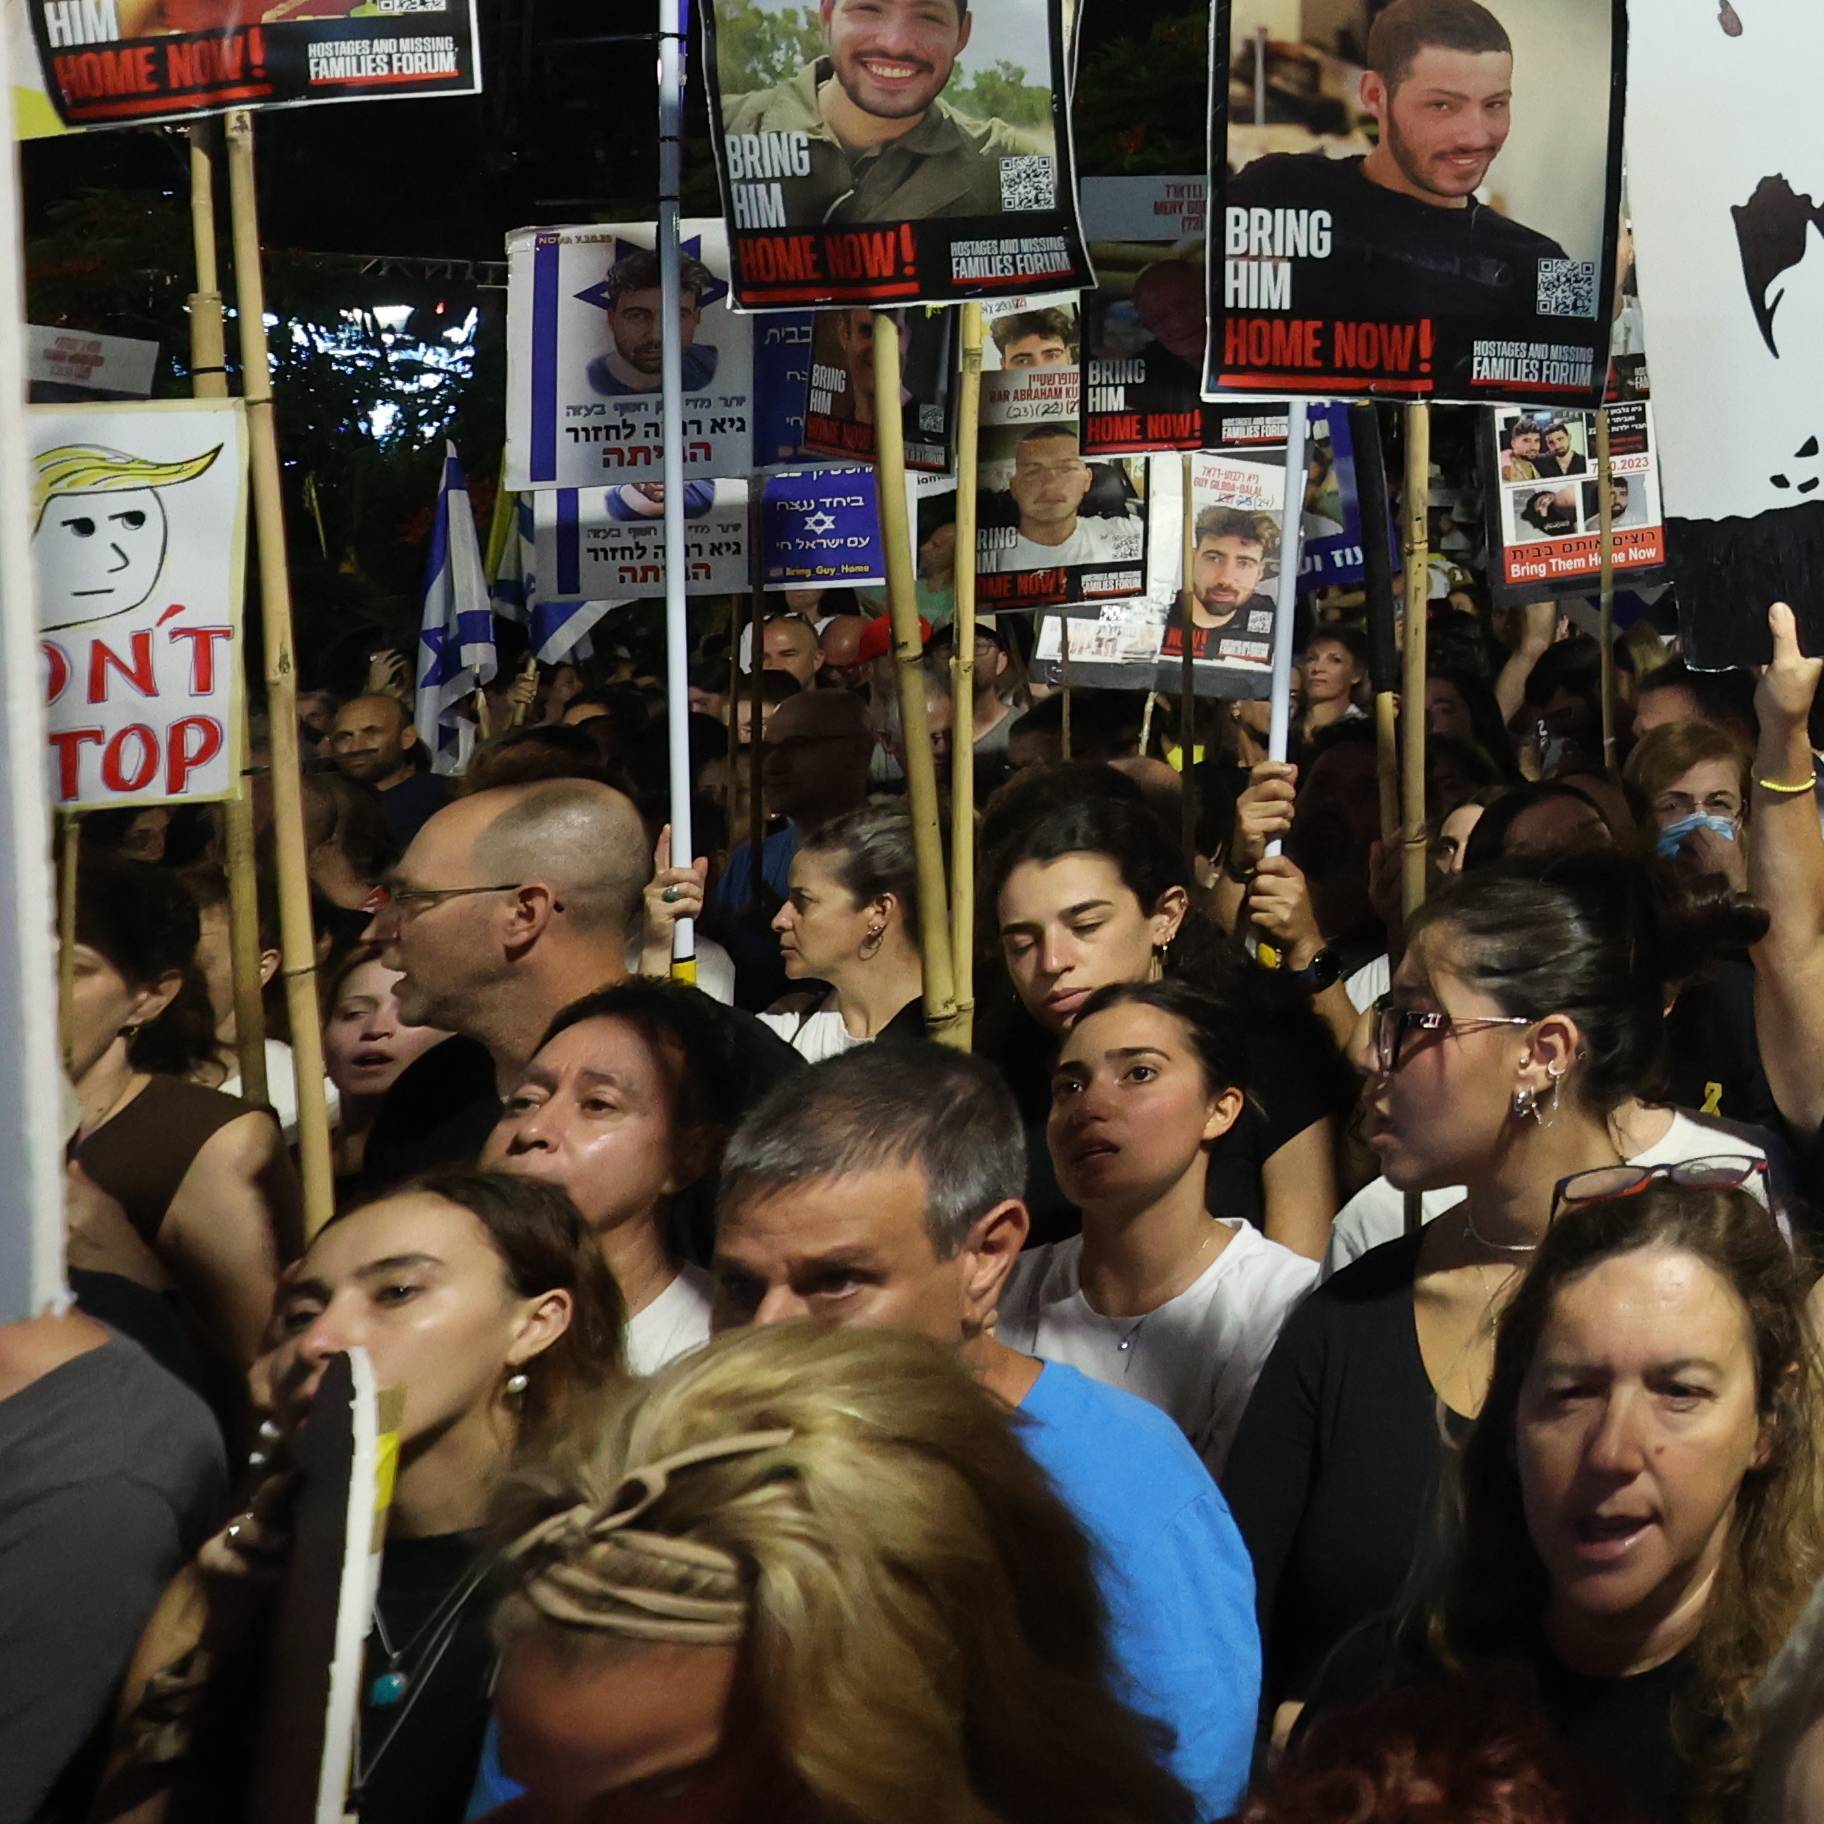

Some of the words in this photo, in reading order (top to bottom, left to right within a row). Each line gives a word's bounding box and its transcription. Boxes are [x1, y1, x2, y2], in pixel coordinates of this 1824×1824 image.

[308, 41, 370, 59] HOSTAGES
[372, 39, 398, 54] AND
[399, 36, 456, 53] MISSING
[53, 48, 158, 97] HOME
[168, 27, 266, 88] NOW!
[309, 53, 389, 80] FAMILIES
[392, 50, 457, 75] FORUM
[726, 132, 810, 179] BRING
[732, 183, 787, 229] HIM
[951, 240, 998, 256] HOSTAGES
[1000, 239, 1018, 254] AND
[1020, 236, 1065, 252] MISSING
[1225, 207, 1333, 259] BRING
[737, 237, 817, 283] HOME
[825, 223, 917, 278] NOW!
[952, 254, 1014, 279] FAMILIES
[1016, 252, 1071, 275] FORUM
[1225, 259, 1292, 311] HIM
[1224, 319, 1323, 367] HOME
[1334, 319, 1436, 374] NOW!
[1473, 340, 1526, 358] HOSTAGES
[1528, 343, 1548, 359] AND
[1550, 344, 1594, 362] MISSING
[812, 364, 846, 393] BRING
[1088, 359, 1146, 385] BRING
[1473, 357, 1539, 382] FAMILIES
[1542, 360, 1592, 386] FORUM
[810, 389, 832, 415] HIM
[1012, 387, 1063, 401] ABRAHAM
[1088, 387, 1126, 412] HIM
[566, 419, 636, 443] לחזור
[710, 417, 746, 434] גיא
[1087, 415, 1142, 442] HOME
[1147, 409, 1202, 439] NOW!
[1222, 426, 1260, 439] FAMILIES
[602, 442, 712, 468] היתה
[820, 496, 864, 508] ביחד
[795, 538, 844, 550] ישראל
[847, 536, 870, 548] עם
[977, 526, 1018, 549] RING
[1612, 531, 1656, 546] רוצים
[1511, 562, 1546, 578] Bring
[1550, 557, 1586, 571] Them
[1629, 547, 1656, 559] Now
[1512, 547, 1554, 560] בבית
[49, 716, 224, 801] TOP
